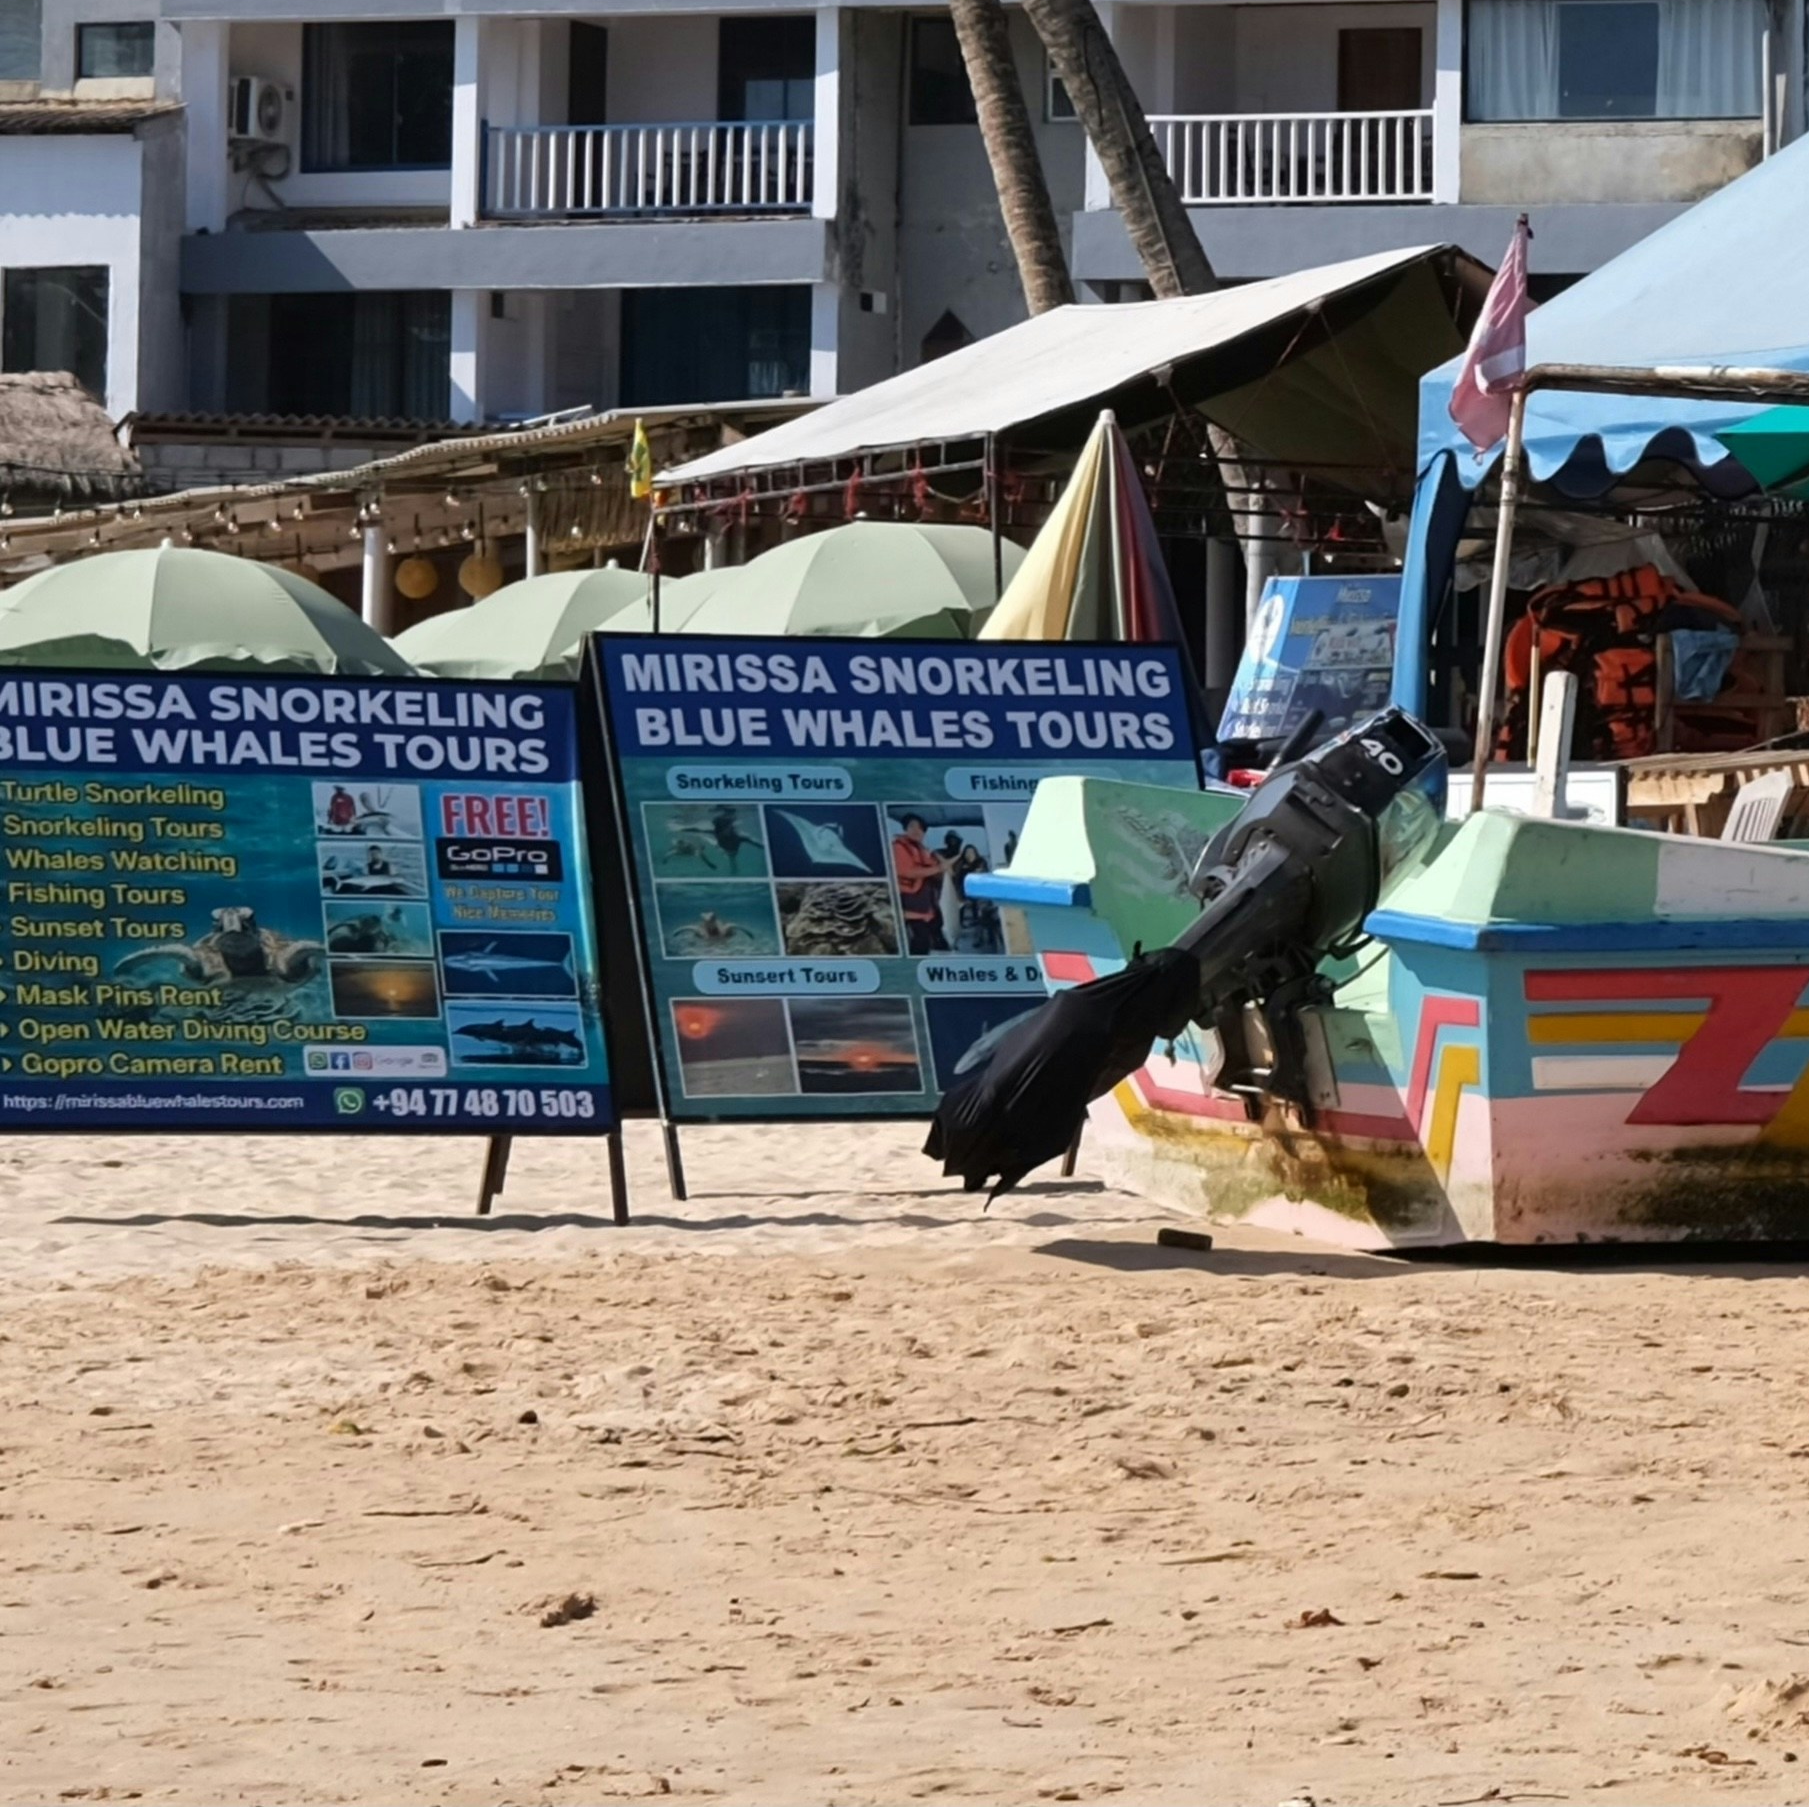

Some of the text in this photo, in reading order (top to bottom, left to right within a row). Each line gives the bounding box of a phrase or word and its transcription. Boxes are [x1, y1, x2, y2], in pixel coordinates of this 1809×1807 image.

[621, 654, 1172, 698] MIRISSA SNORKELING
[208, 686, 546, 730] SNORKELING
[635, 708, 1175, 750] BLUE WHALES TOURS
[131, 728, 362, 769] WHALES
[373, 734, 549, 774] TOURS
[1360, 738, 1404, 775] 40
[0, 781, 225, 810] Turtle Snorkeling
[675, 773, 845, 793] Snorkeling Tours
[4, 815, 223, 842] Snorkeling Tours
[441, 794, 550, 837] FREE!
[6, 849, 236, 876] Whales Watching
[446, 845, 548, 863] GoPro
[9, 882, 185, 908] Fishing Tours
[11, 916, 185, 938] Sunset Tours
[14, 951, 98, 976] Diving
[717, 967, 858, 984] Sunsert Tours
[926, 965, 997, 982] Whales
[1004, 966, 1019, 982] &
[17, 986, 222, 1006] Mask Pins Rent
[18, 1019, 368, 1045] Open Water Diving Course
[21, 1053, 283, 1078] Gopro Camera Rent
[4, 1093, 304, 1110] https://mirissabluewhalestours.com
[372, 1088, 596, 1118] +94 77 48 70 503
